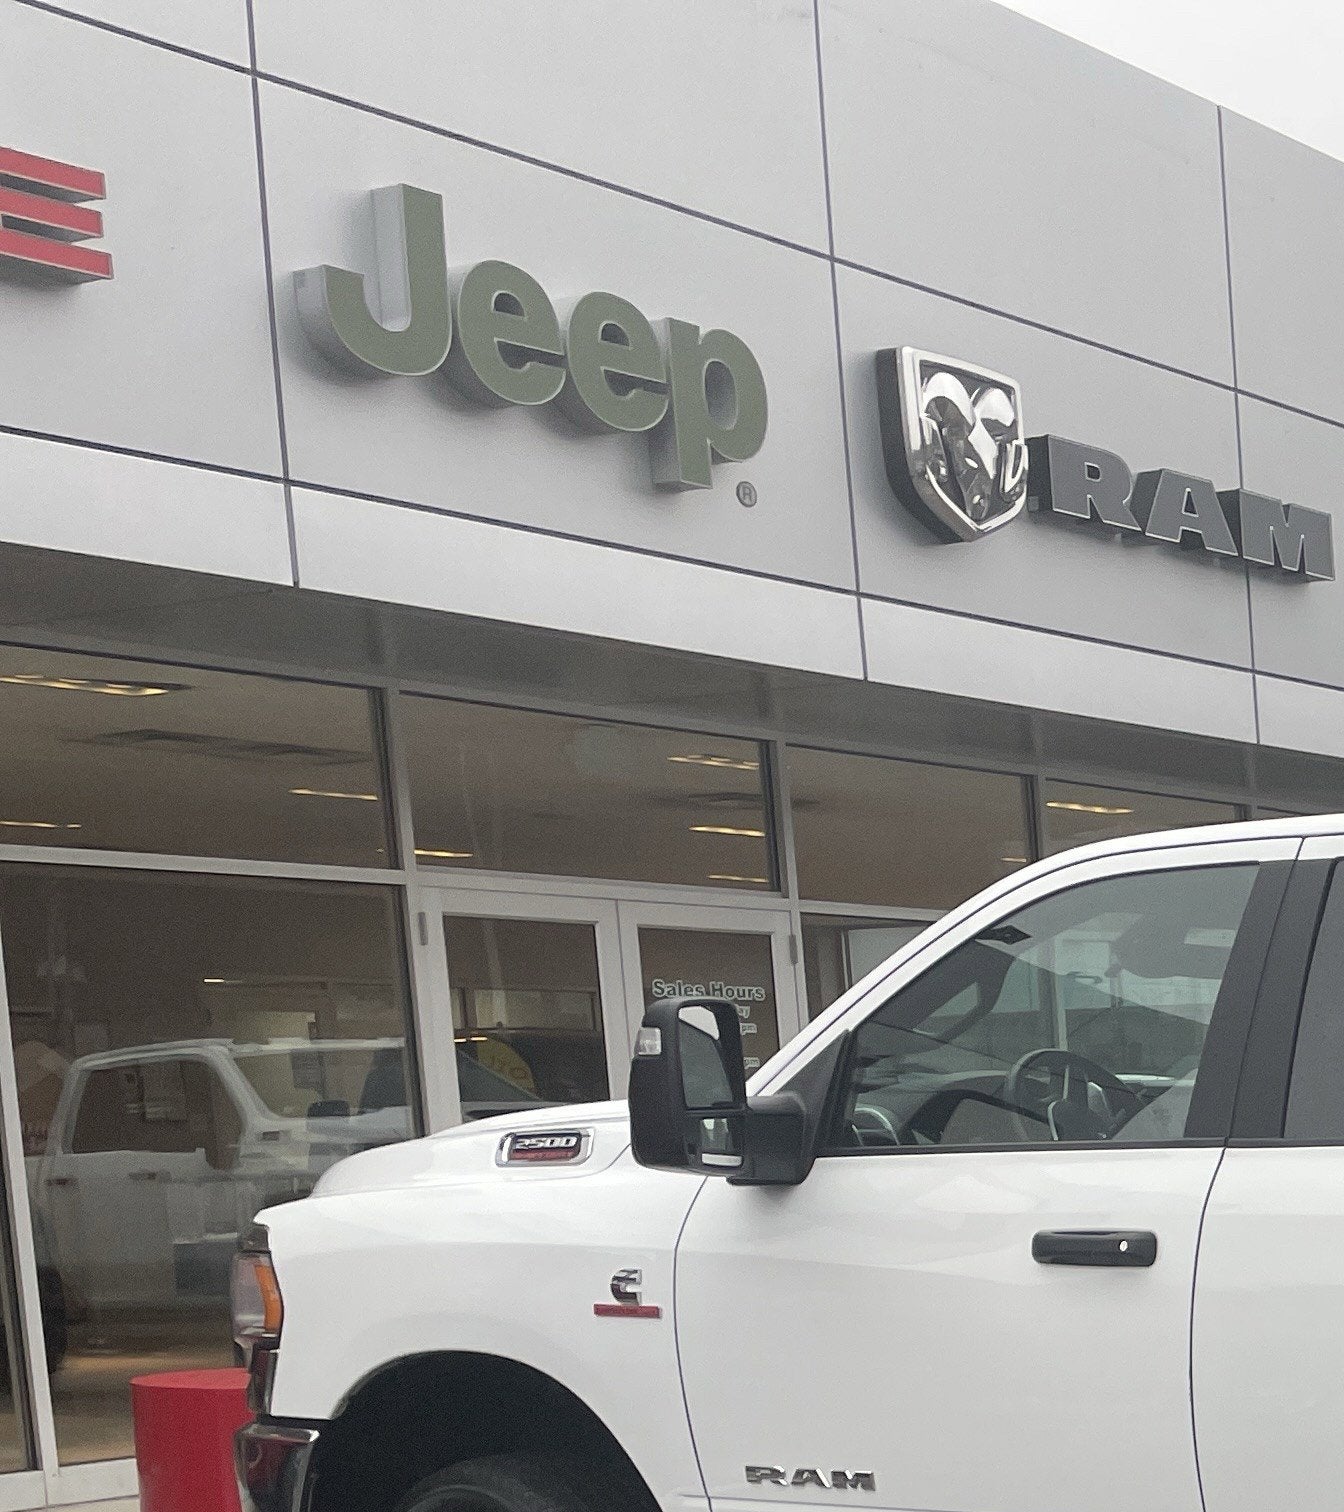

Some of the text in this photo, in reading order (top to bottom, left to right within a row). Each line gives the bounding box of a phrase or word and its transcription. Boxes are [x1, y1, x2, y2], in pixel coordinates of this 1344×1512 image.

[298, 183, 768, 490] Jeep
[1030, 434, 1336, 581] RAM
[652, 979, 766, 1002] Sales Hours
[515, 1136, 578, 1150] 2500
[745, 1465, 876, 1492] RAM
